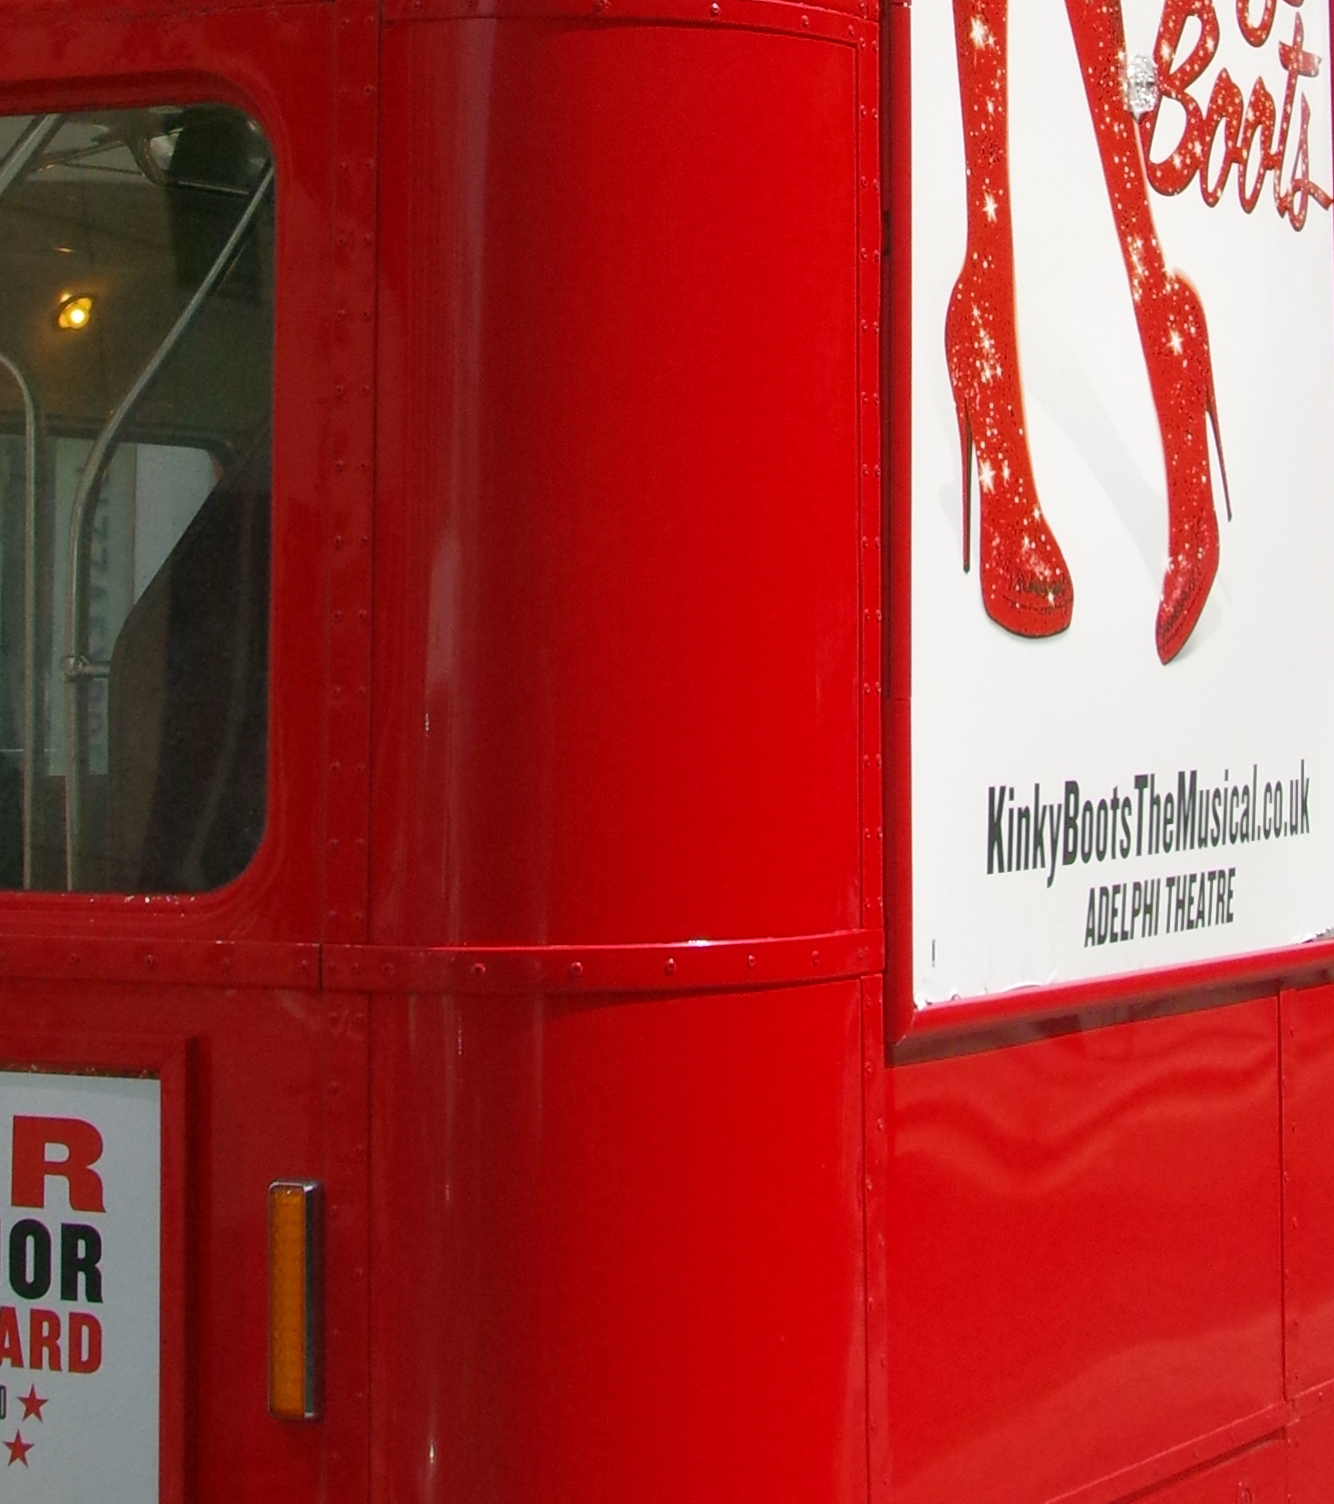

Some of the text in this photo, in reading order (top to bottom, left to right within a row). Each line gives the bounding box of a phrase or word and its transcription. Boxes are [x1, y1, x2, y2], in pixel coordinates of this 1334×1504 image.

[986, 759, 1311, 889] KinkyBootsTheMusical.co.uk
[1084, 867, 1236, 948] ADELPHI THEATRE
